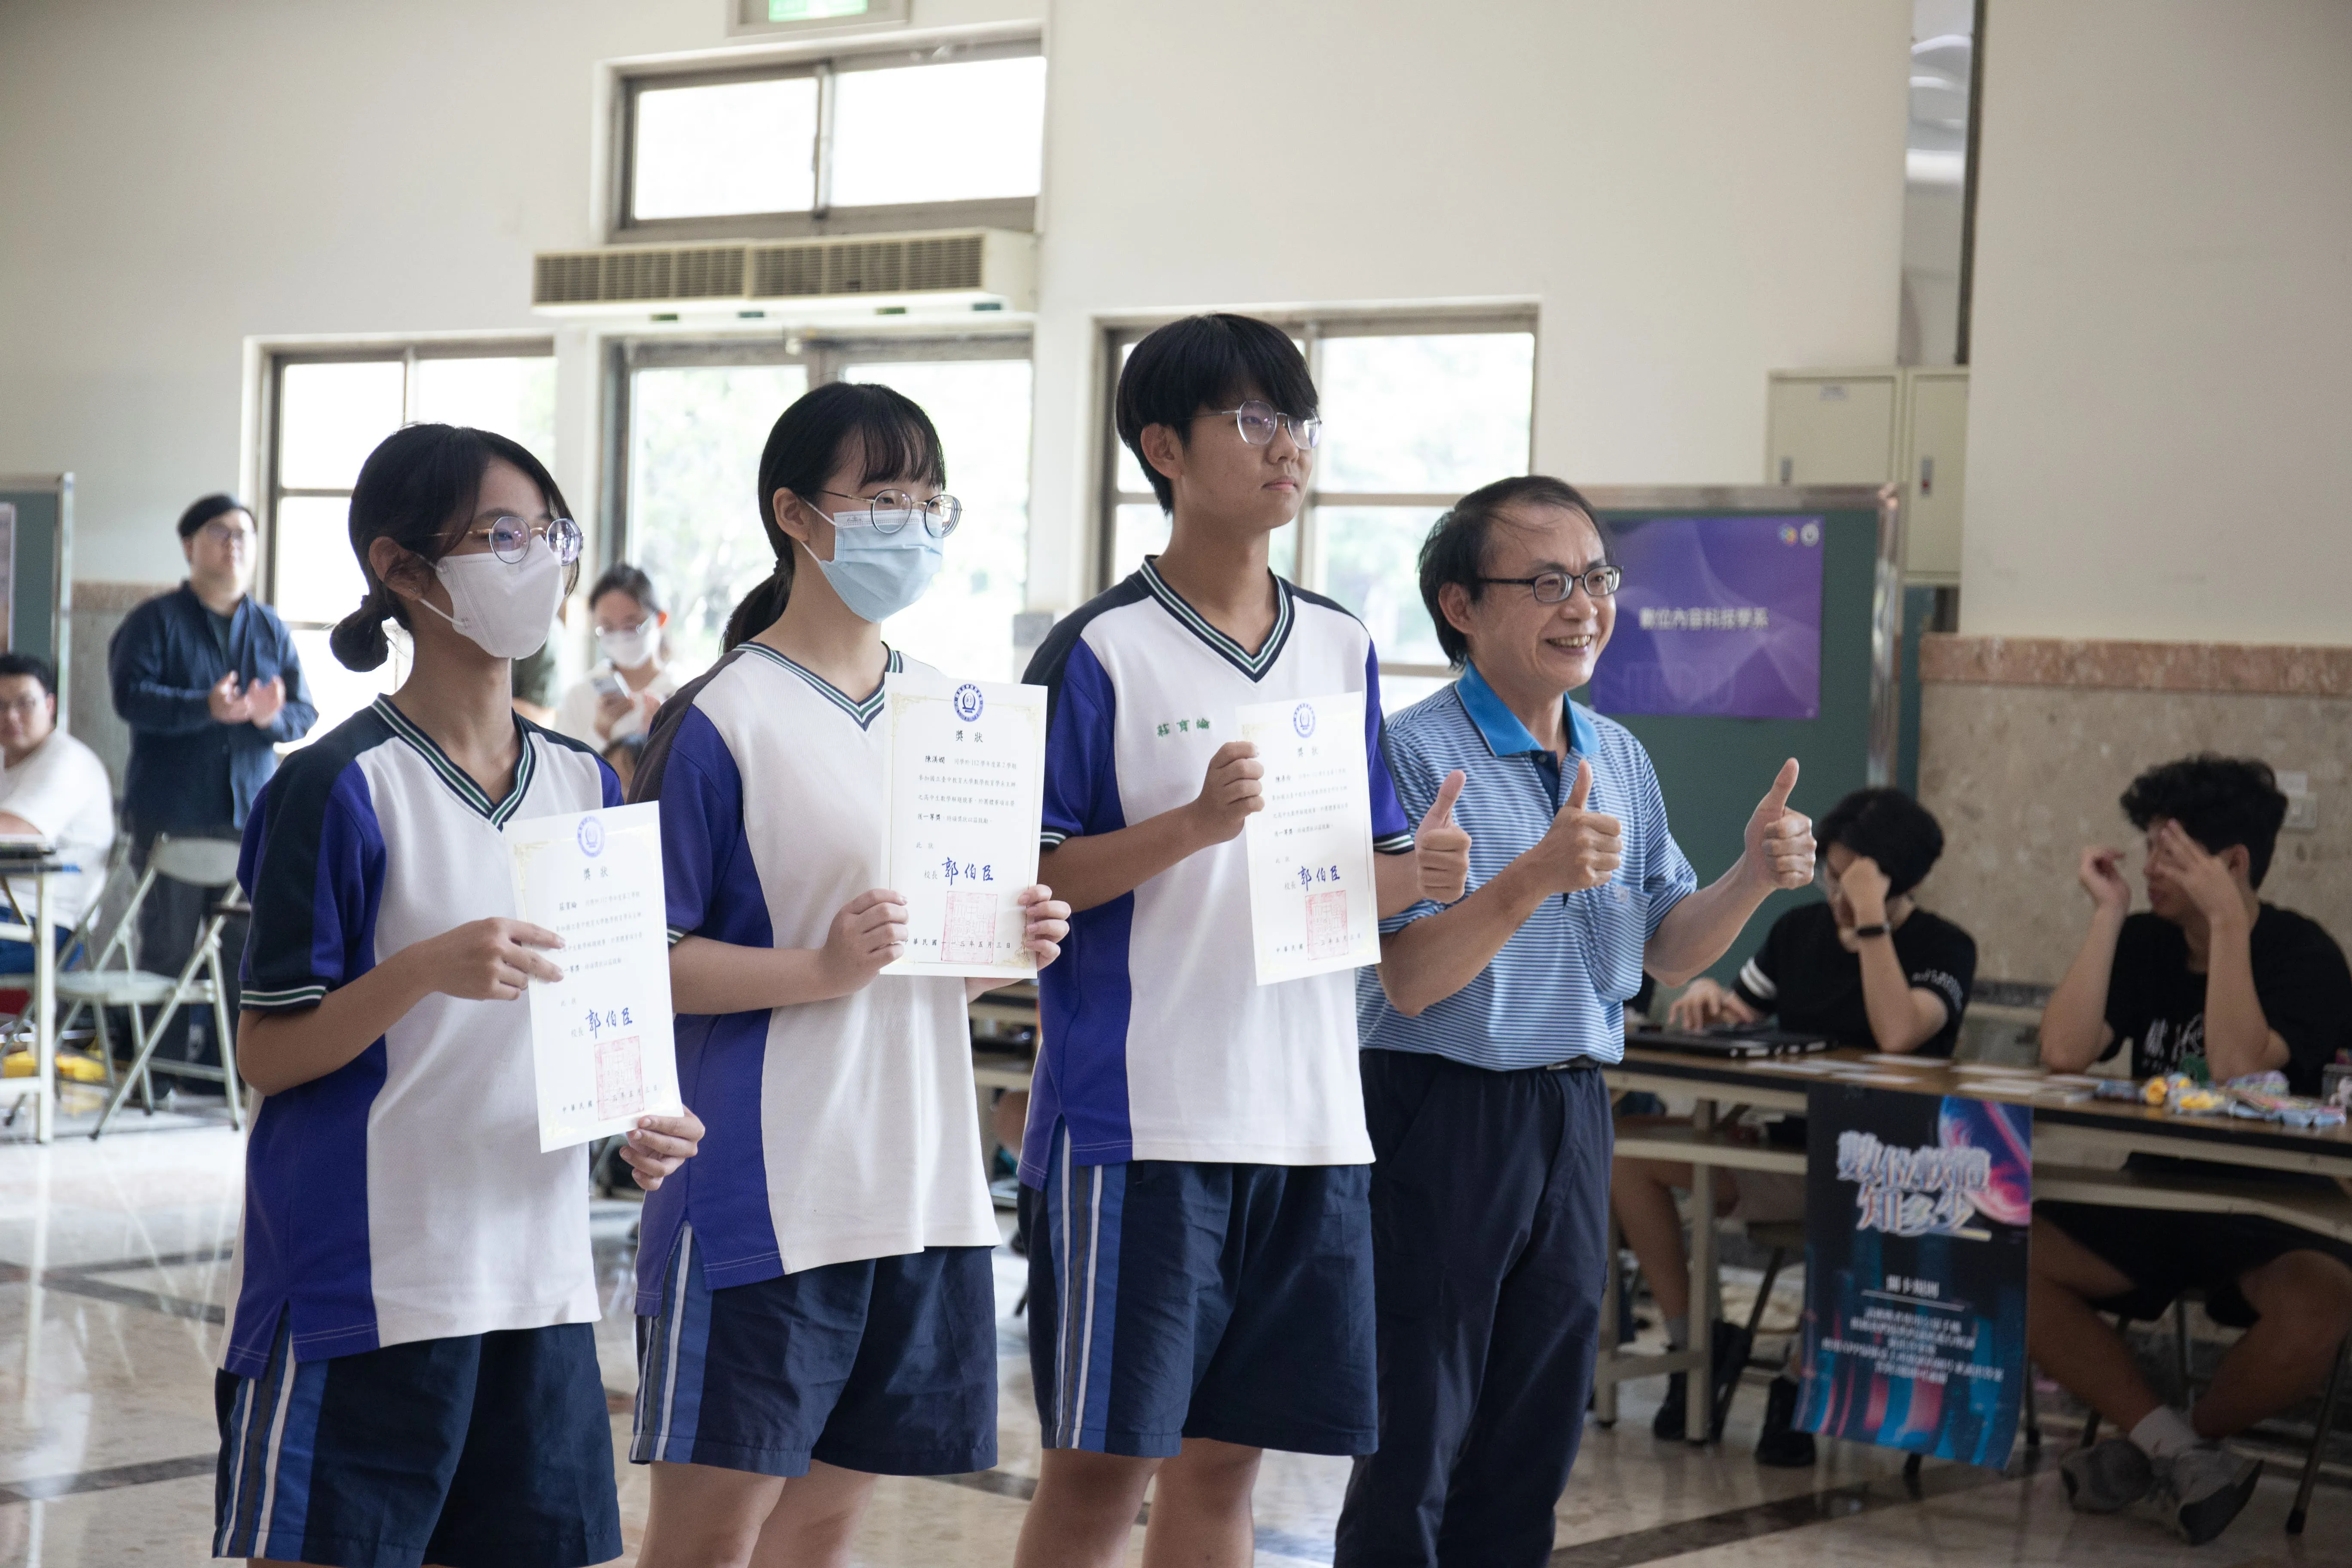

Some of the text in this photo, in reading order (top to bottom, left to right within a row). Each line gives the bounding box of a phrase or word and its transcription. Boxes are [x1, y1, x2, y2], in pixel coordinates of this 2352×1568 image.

[955, 729, 983, 743] 獎狀
[924, 856, 994, 886] 校長 郭伯臣
[1284, 865, 1341, 891] 校長 郭伯臣
[571, 1007, 633, 1040] 校長 郭伯臣
